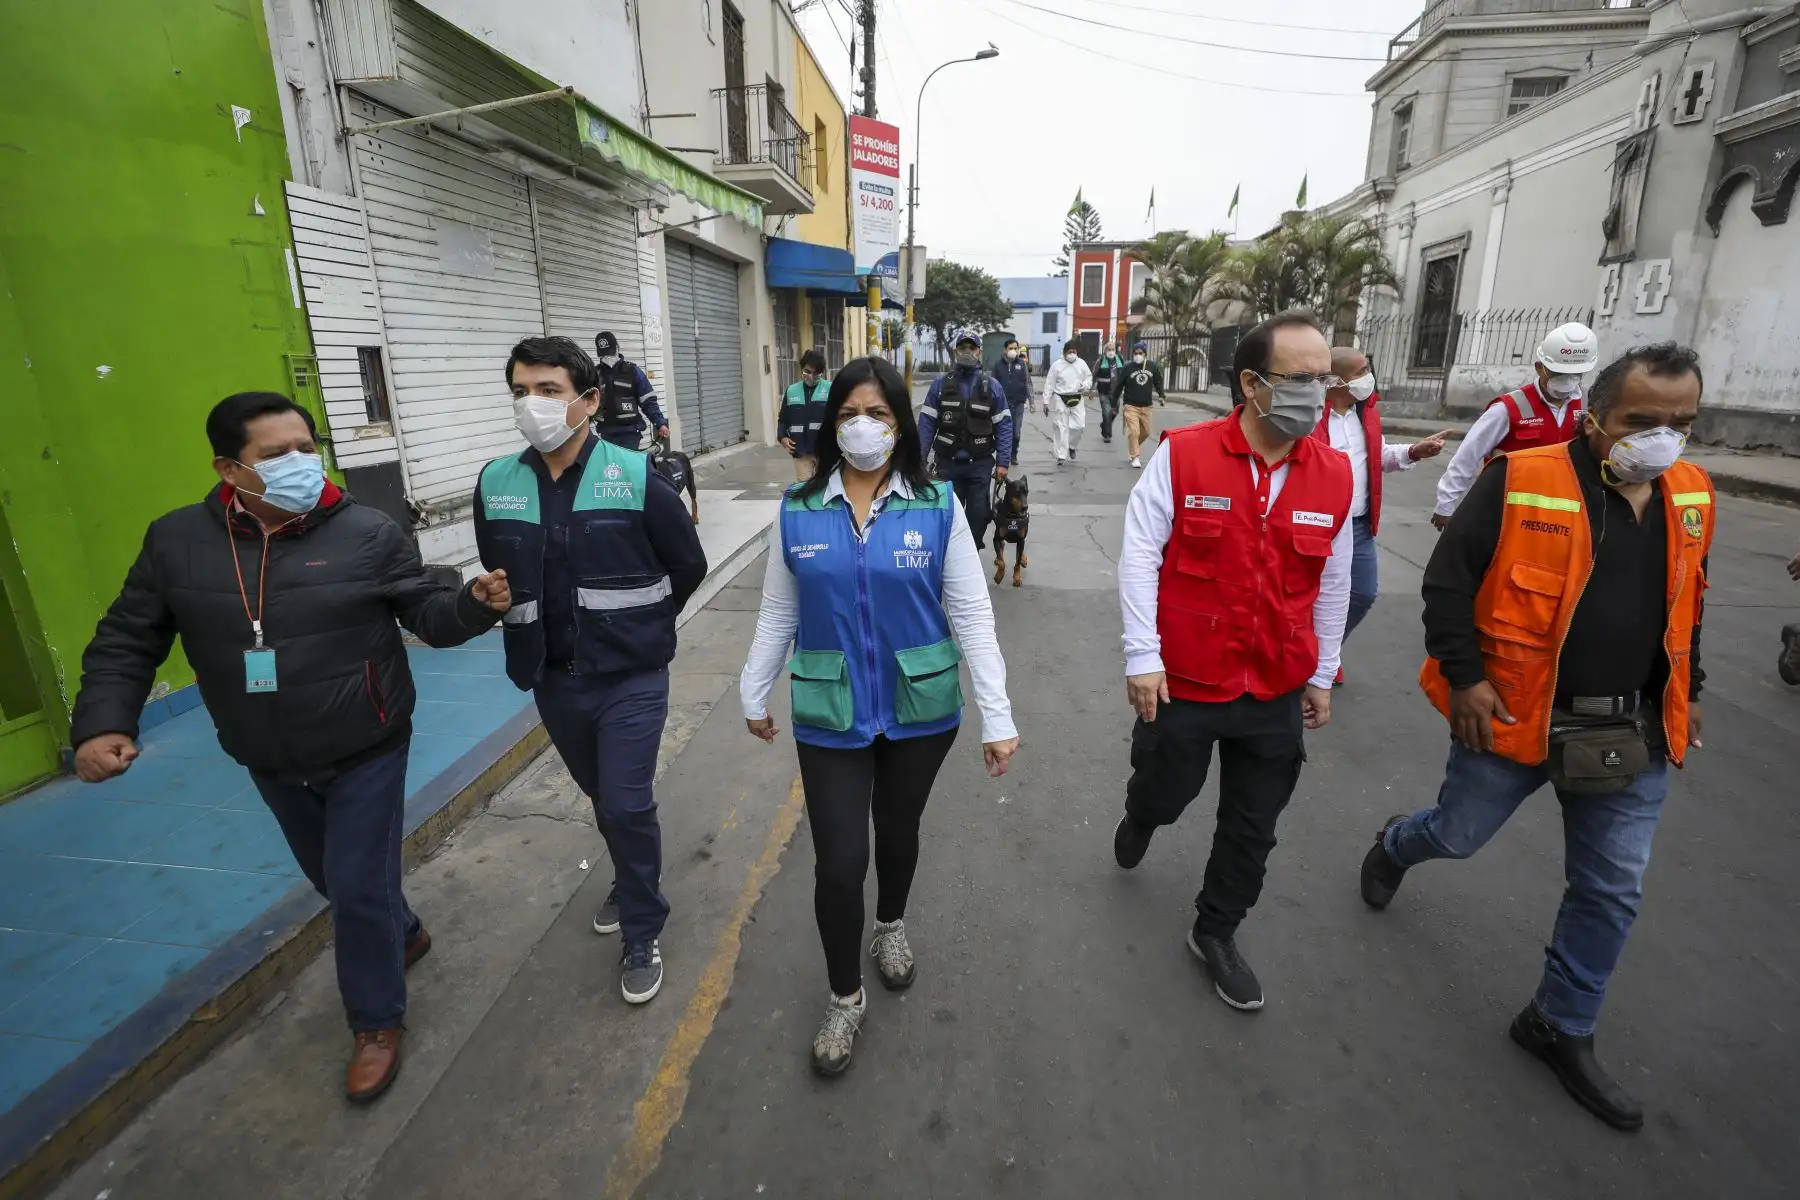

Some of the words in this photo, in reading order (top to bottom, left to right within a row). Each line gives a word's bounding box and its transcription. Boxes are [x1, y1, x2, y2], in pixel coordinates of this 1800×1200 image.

[853, 133, 863, 146] SE
[864, 136, 898, 155] PROHÍBE
[853, 148, 898, 168] JALADORES
[860, 194, 869, 207] S/
[871, 196, 894, 211] 4,200
[486, 495, 528, 503] DESARROLLO
[594, 487, 633, 498] LIMA
[488, 502, 526, 510] ECONÓMICO
[1520, 519, 1570, 537] PRESIDENTE
[896, 556, 929, 569] LIMA
